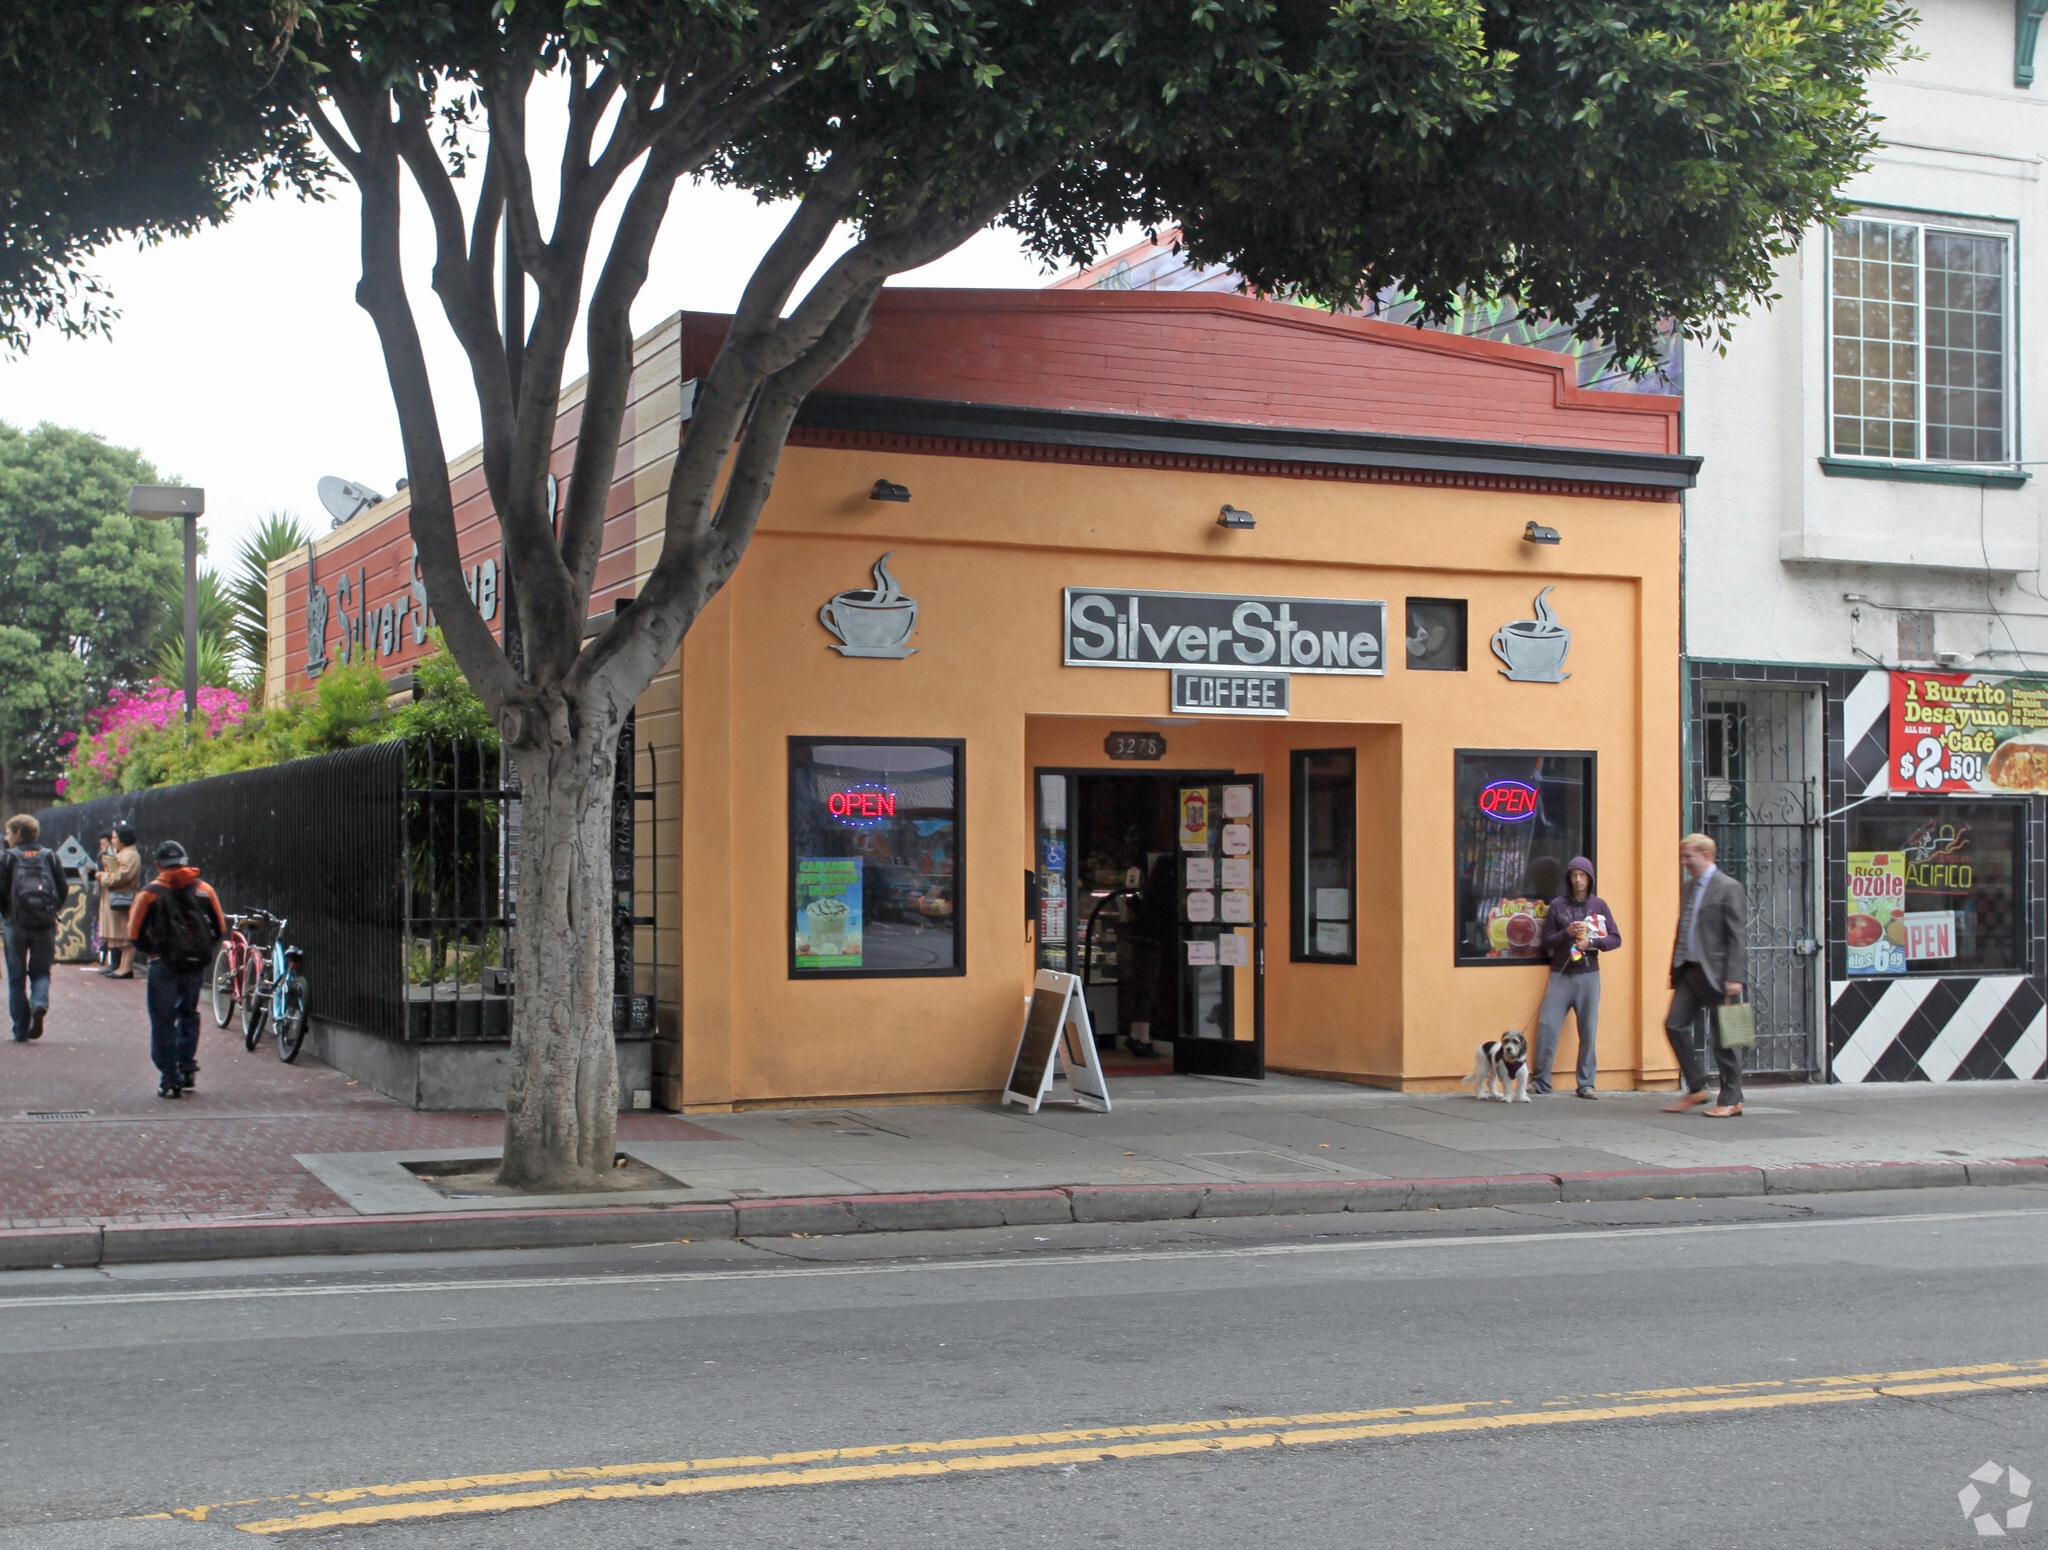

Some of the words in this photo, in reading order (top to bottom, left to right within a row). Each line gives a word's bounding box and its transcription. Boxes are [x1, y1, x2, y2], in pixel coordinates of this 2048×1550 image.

[1185, 676, 1277, 708] COFFEE
[1906, 679, 1918, 700] 1
[1924, 680, 2006, 704] Burrito
[1904, 701, 2009, 729] Desayuno
[1904, 726, 1917, 734] ALL
[1918, 726, 1932, 734] DAY
[1116, 738, 1157, 756] 3278
[827, 792, 896, 816] OPEN
[1480, 788, 1539, 812] OPEN
[1855, 866, 1883, 876] RICO
[1905, 864, 1972, 888] ACIFICO
[1848, 954, 1864, 966] olo
